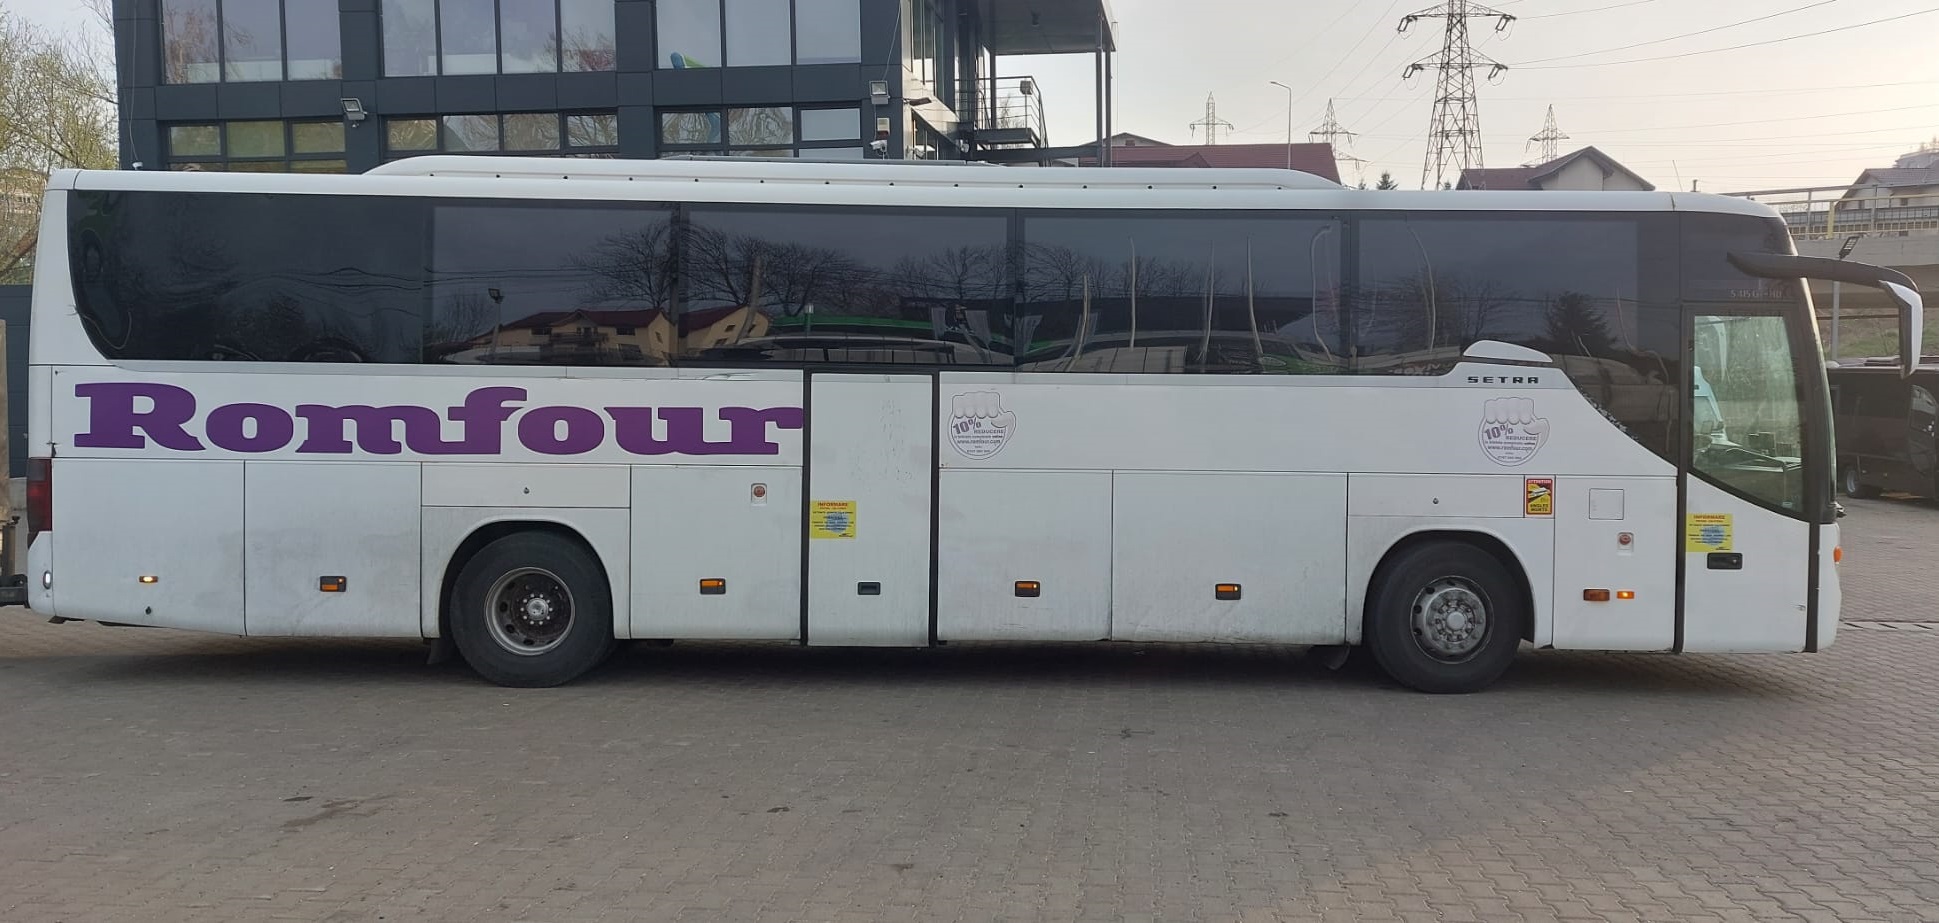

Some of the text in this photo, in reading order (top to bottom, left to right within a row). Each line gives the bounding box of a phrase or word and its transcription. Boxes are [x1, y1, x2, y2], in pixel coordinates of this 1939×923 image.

[1467, 376, 1539, 384] SETRA
[74, 382, 804, 456] Romfour
[952, 417, 982, 435] 10%
[1484, 424, 1514, 440] 10%
